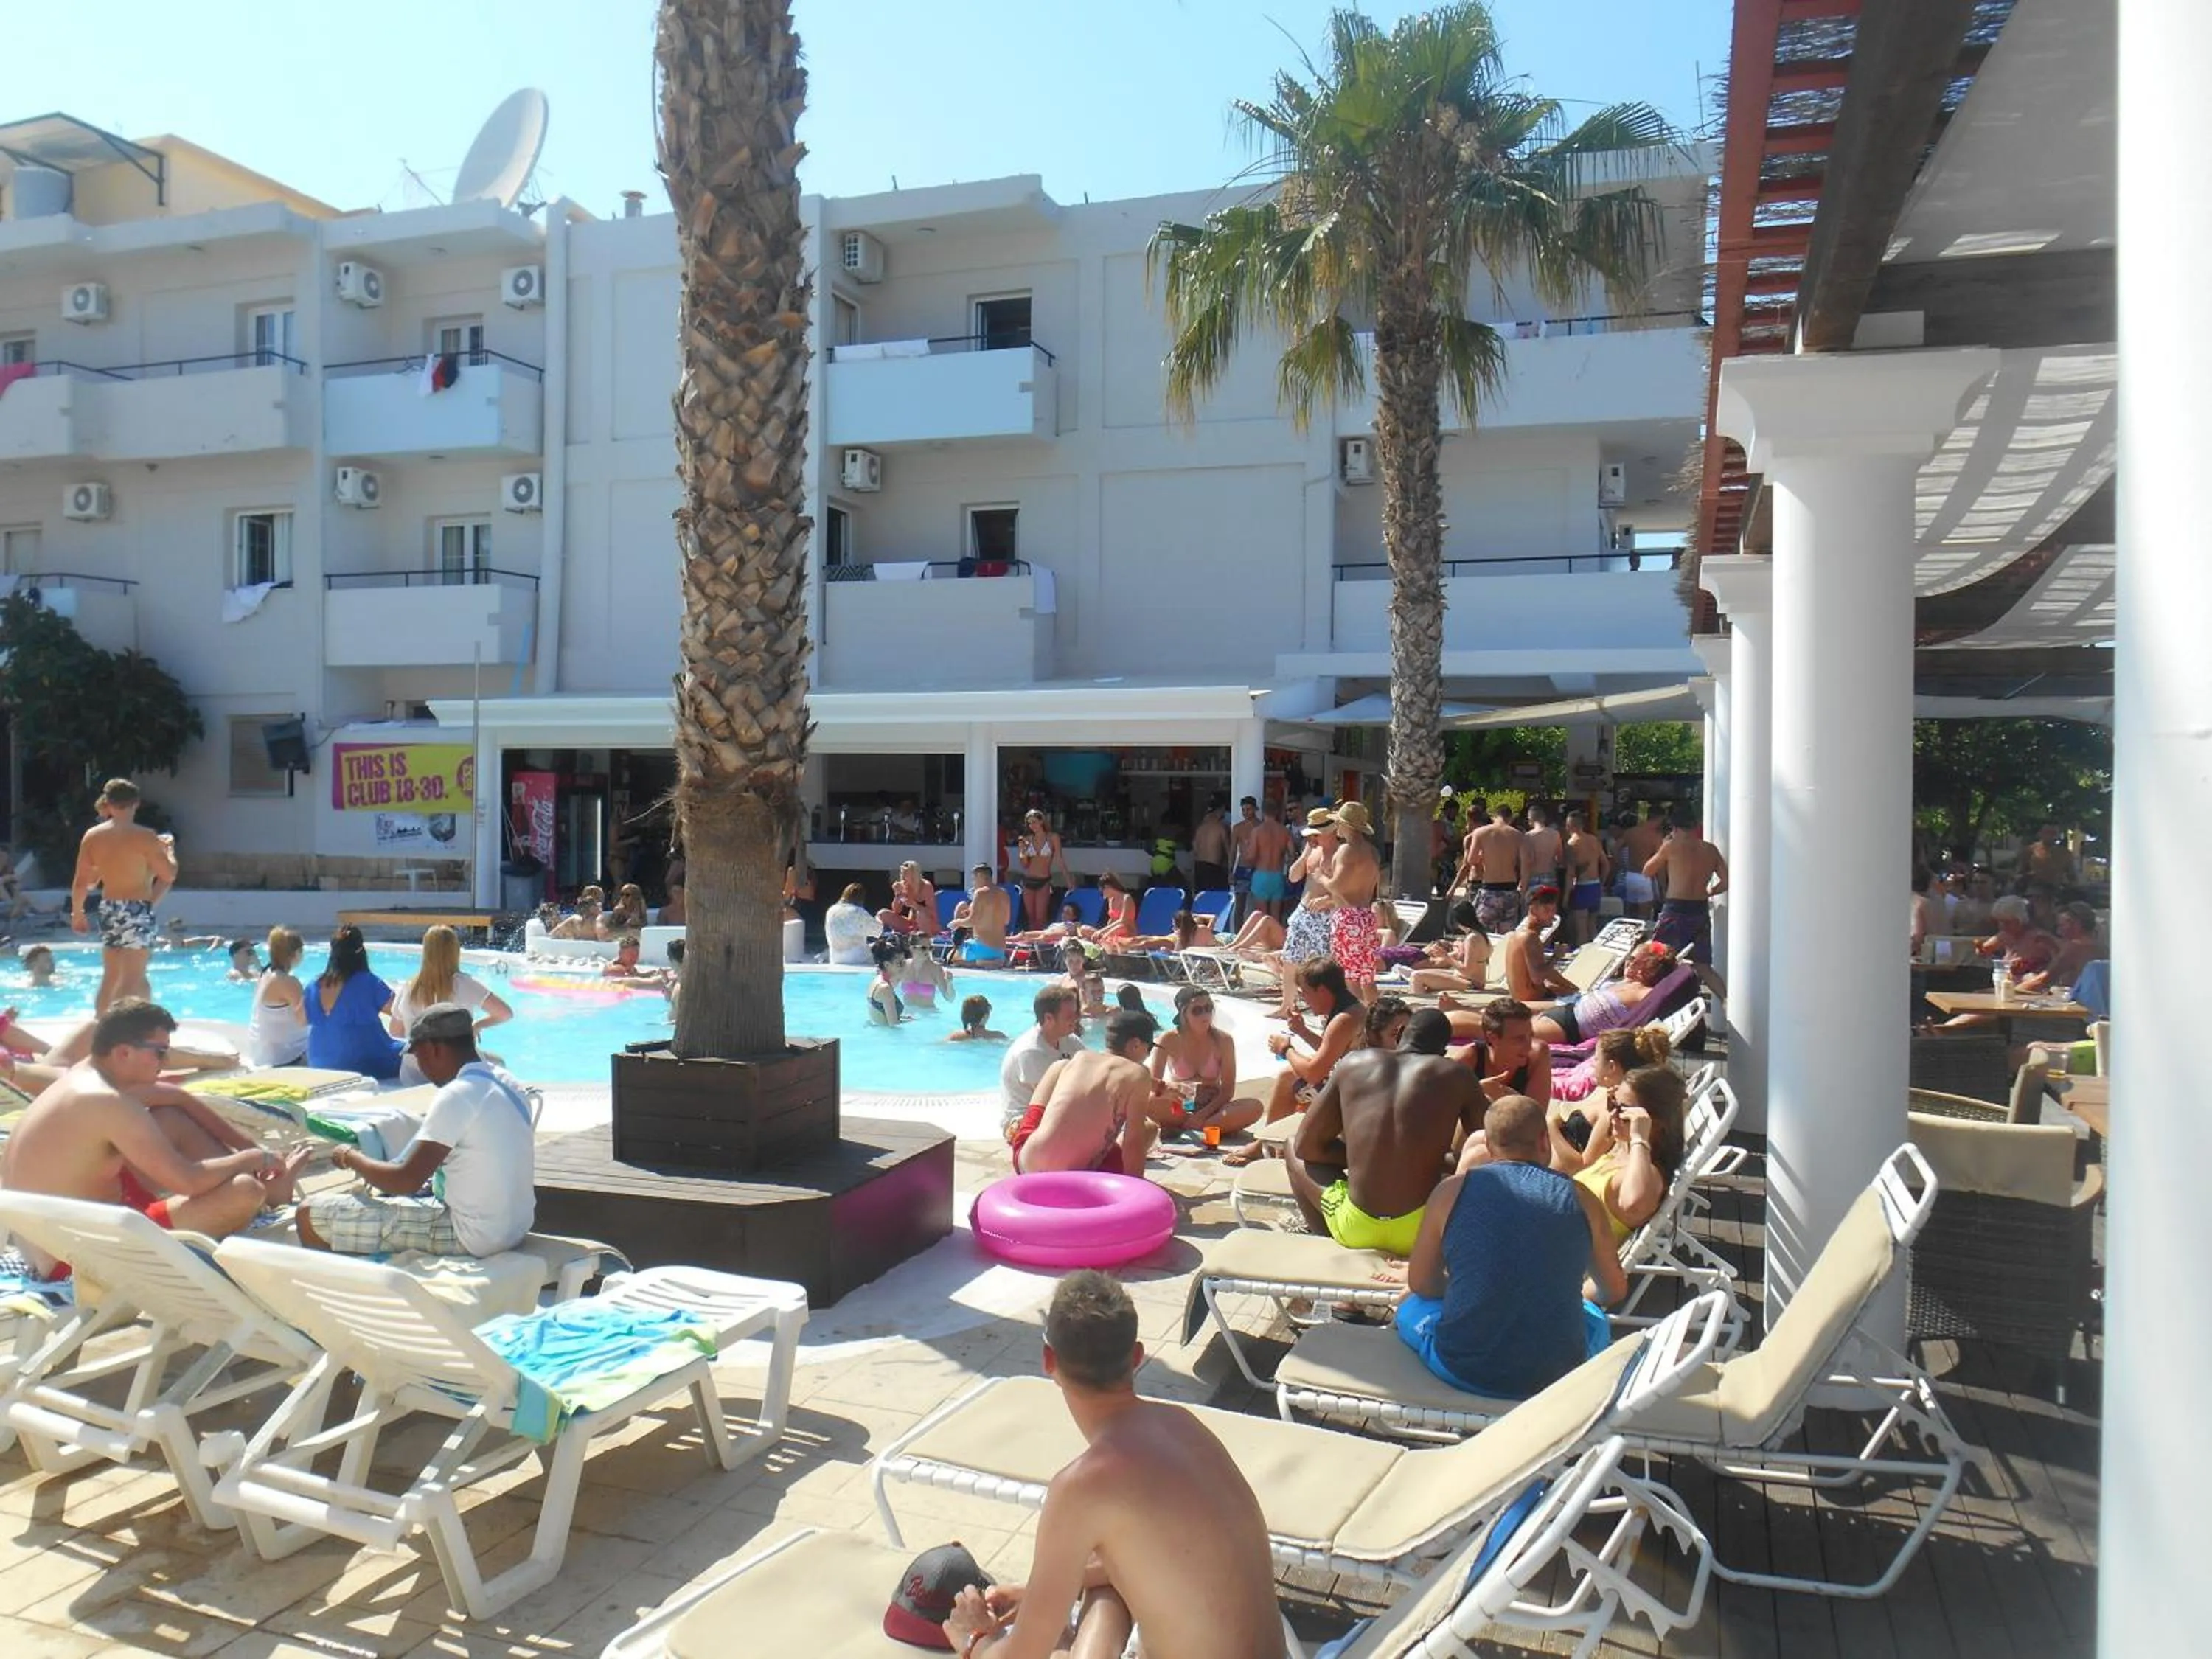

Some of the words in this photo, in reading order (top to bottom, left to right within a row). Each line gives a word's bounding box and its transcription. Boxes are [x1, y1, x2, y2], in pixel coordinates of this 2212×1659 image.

[345, 754, 384, 780] THIS
[389, 752, 407, 776] IS
[348, 779, 391, 806] CLUB
